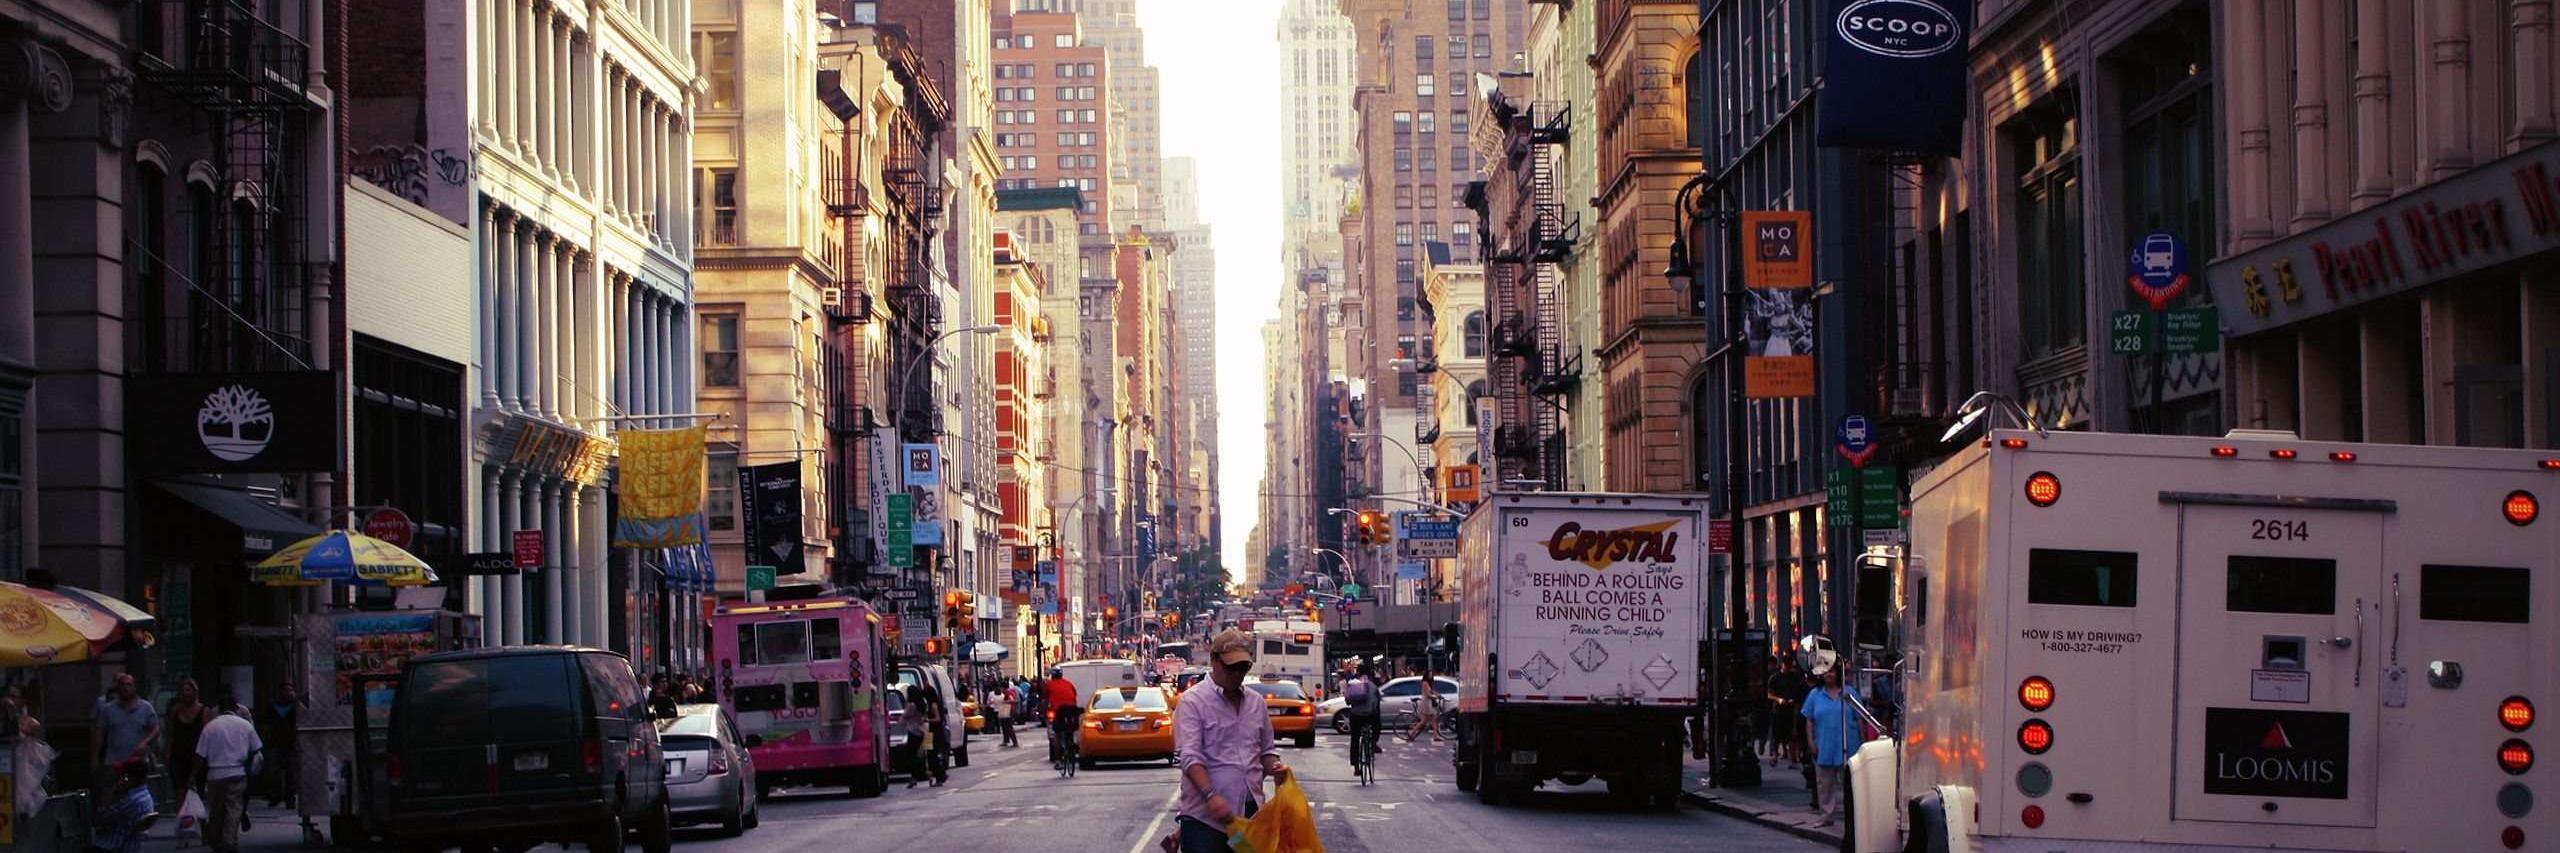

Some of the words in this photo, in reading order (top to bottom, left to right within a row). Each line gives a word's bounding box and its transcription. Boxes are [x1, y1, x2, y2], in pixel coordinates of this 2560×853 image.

[1850, 16, 1948, 37] SCOOP
[1884, 37, 1908, 46] NYC
[2310, 216, 2406, 302] Pearl
[2401, 200, 2511, 270] River
[2511, 161, 2560, 242] M
[1512, 517, 1529, 529] 60
[2252, 519, 2308, 541] 2614
[1549, 521, 1678, 563] CRYSTAL
[473, 559, 512, 571] ALDO
[1646, 563, 1674, 575] Says
[1595, 574, 1608, 588] A
[1612, 574, 1684, 590] ROLLING
[1032, 597, 1044, 605] 30
[1542, 590, 1581, 604] BALL
[1585, 590, 1646, 606] COMES
[1651, 592, 1664, 606] A
[1536, 606, 1611, 621] RUNNING
[1569, 624, 1601, 636] Please
[1602, 625, 1630, 636] Drive
[1632, 626, 1666, 639] Safely
[2021, 630, 2049, 640] HOW
[2053, 631, 2064, 640] IS
[2067, 631, 2084, 641] MY
[2088, 632, 2143, 644] DRIVING?
[2042, 642, 2124, 655] 1-800-327-4677
[2218, 752, 2335, 784] LOOMIS
